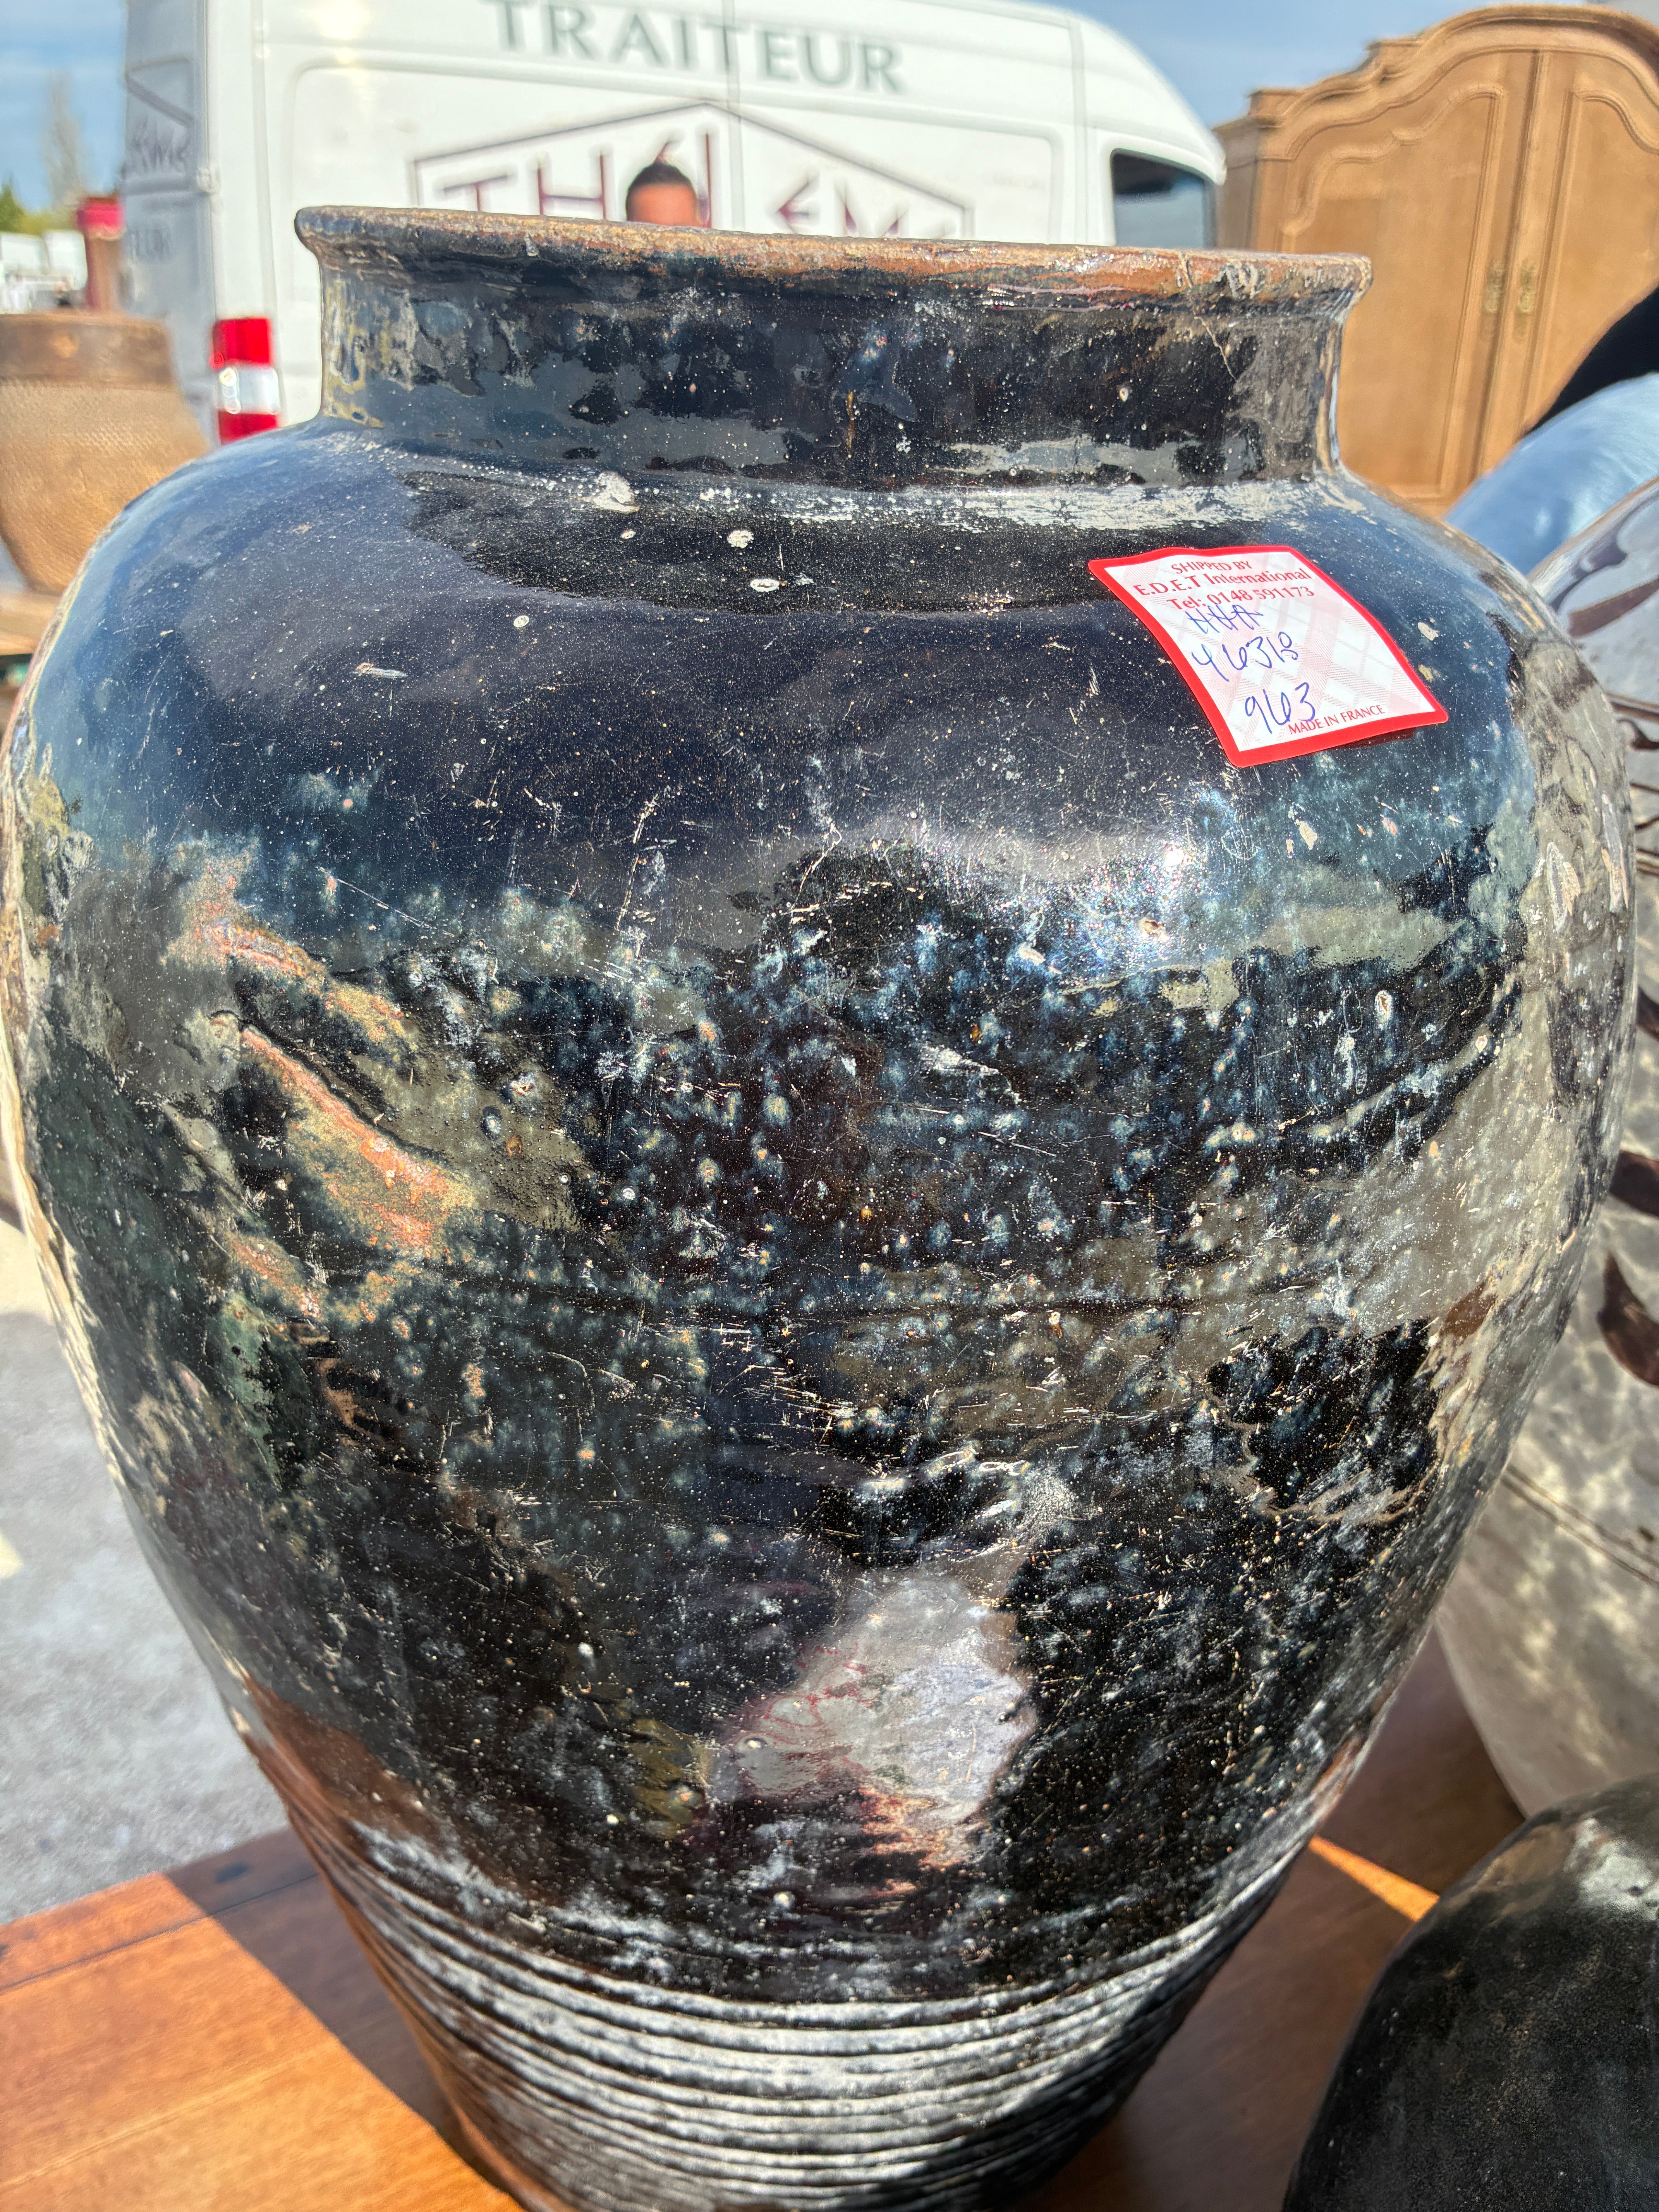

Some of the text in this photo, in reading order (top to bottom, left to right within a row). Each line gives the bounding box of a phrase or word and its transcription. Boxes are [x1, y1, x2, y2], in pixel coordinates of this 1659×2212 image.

[482, 0, 907, 95] TRAITEUR
[1171, 560, 1252, 574] SHIPPED BY
[1133, 568, 1312, 596] E.D.E.T International
[1166, 586, 1315, 610] Tel: 0148 591173
[1245, 682, 1316, 734] 963
[1288, 705, 1386, 735] MADE IN FRANCE
